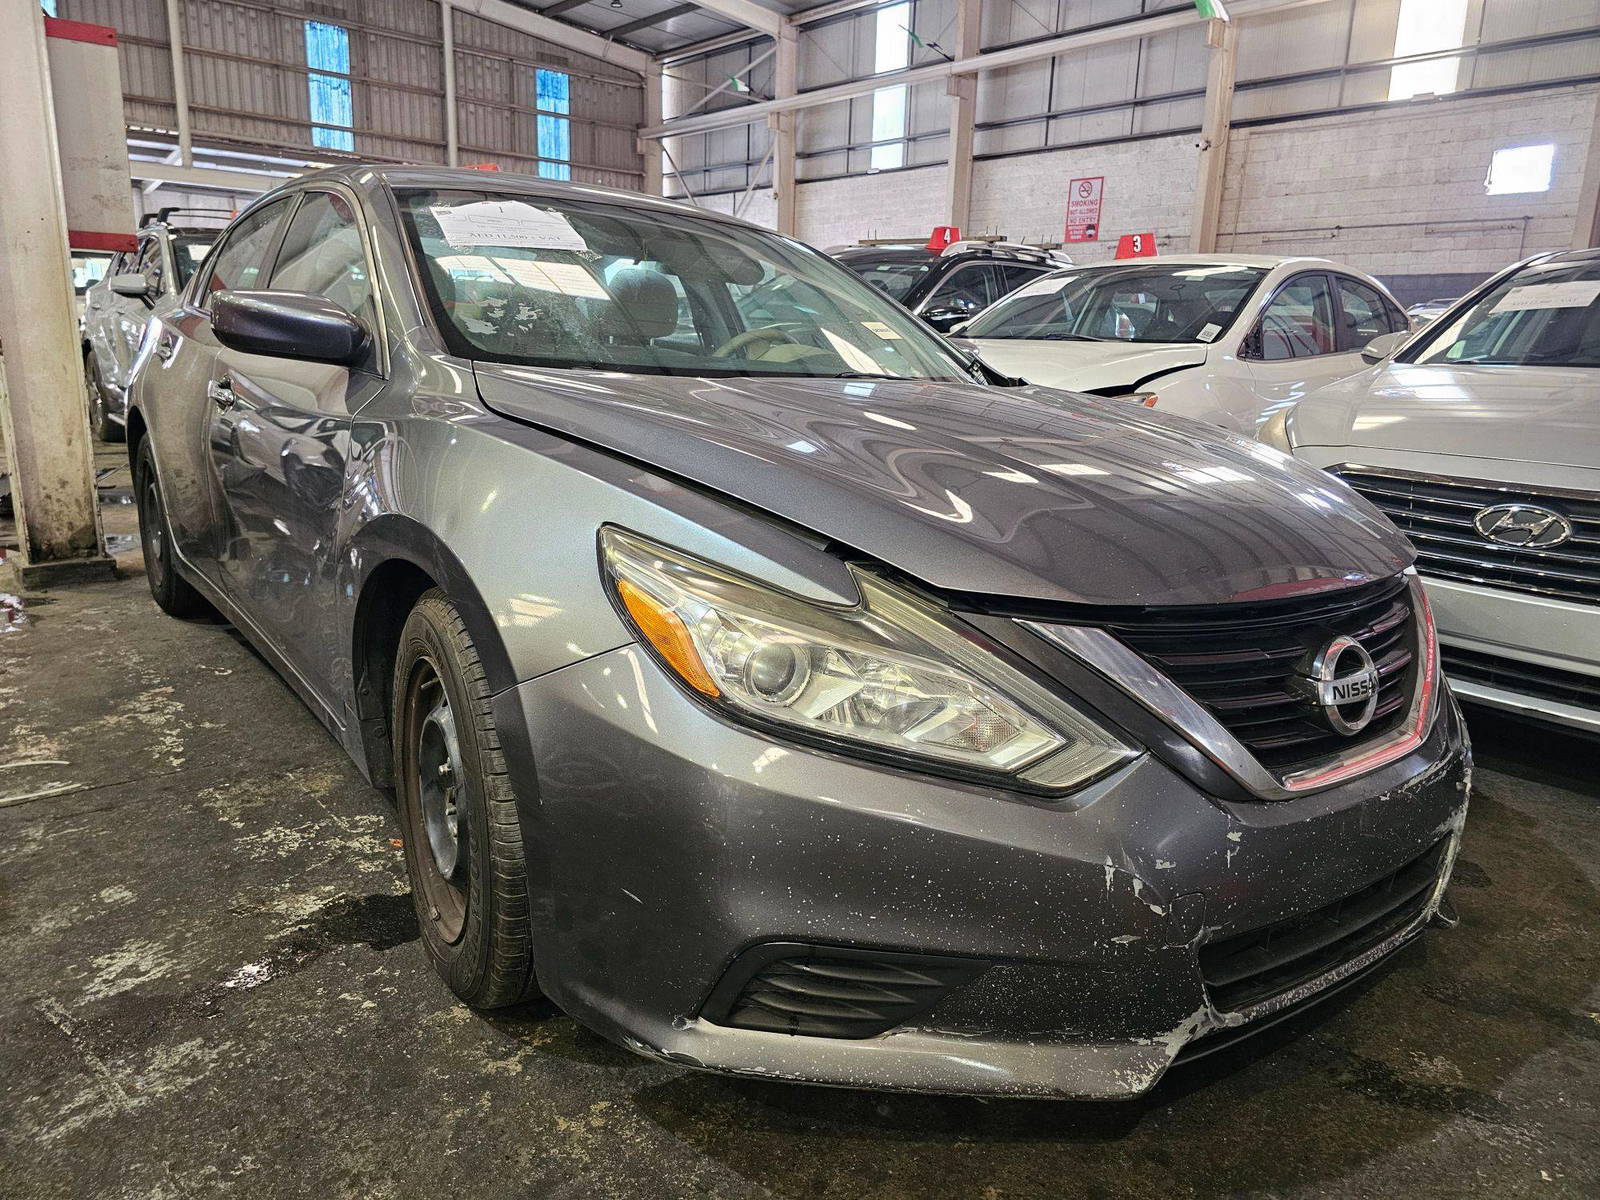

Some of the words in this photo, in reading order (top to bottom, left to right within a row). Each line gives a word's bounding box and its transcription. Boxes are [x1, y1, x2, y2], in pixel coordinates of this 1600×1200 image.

[1071, 200, 1098, 208] SMOKING
[943, 228, 951, 244] 4
[1133, 235, 1142, 253] 3
